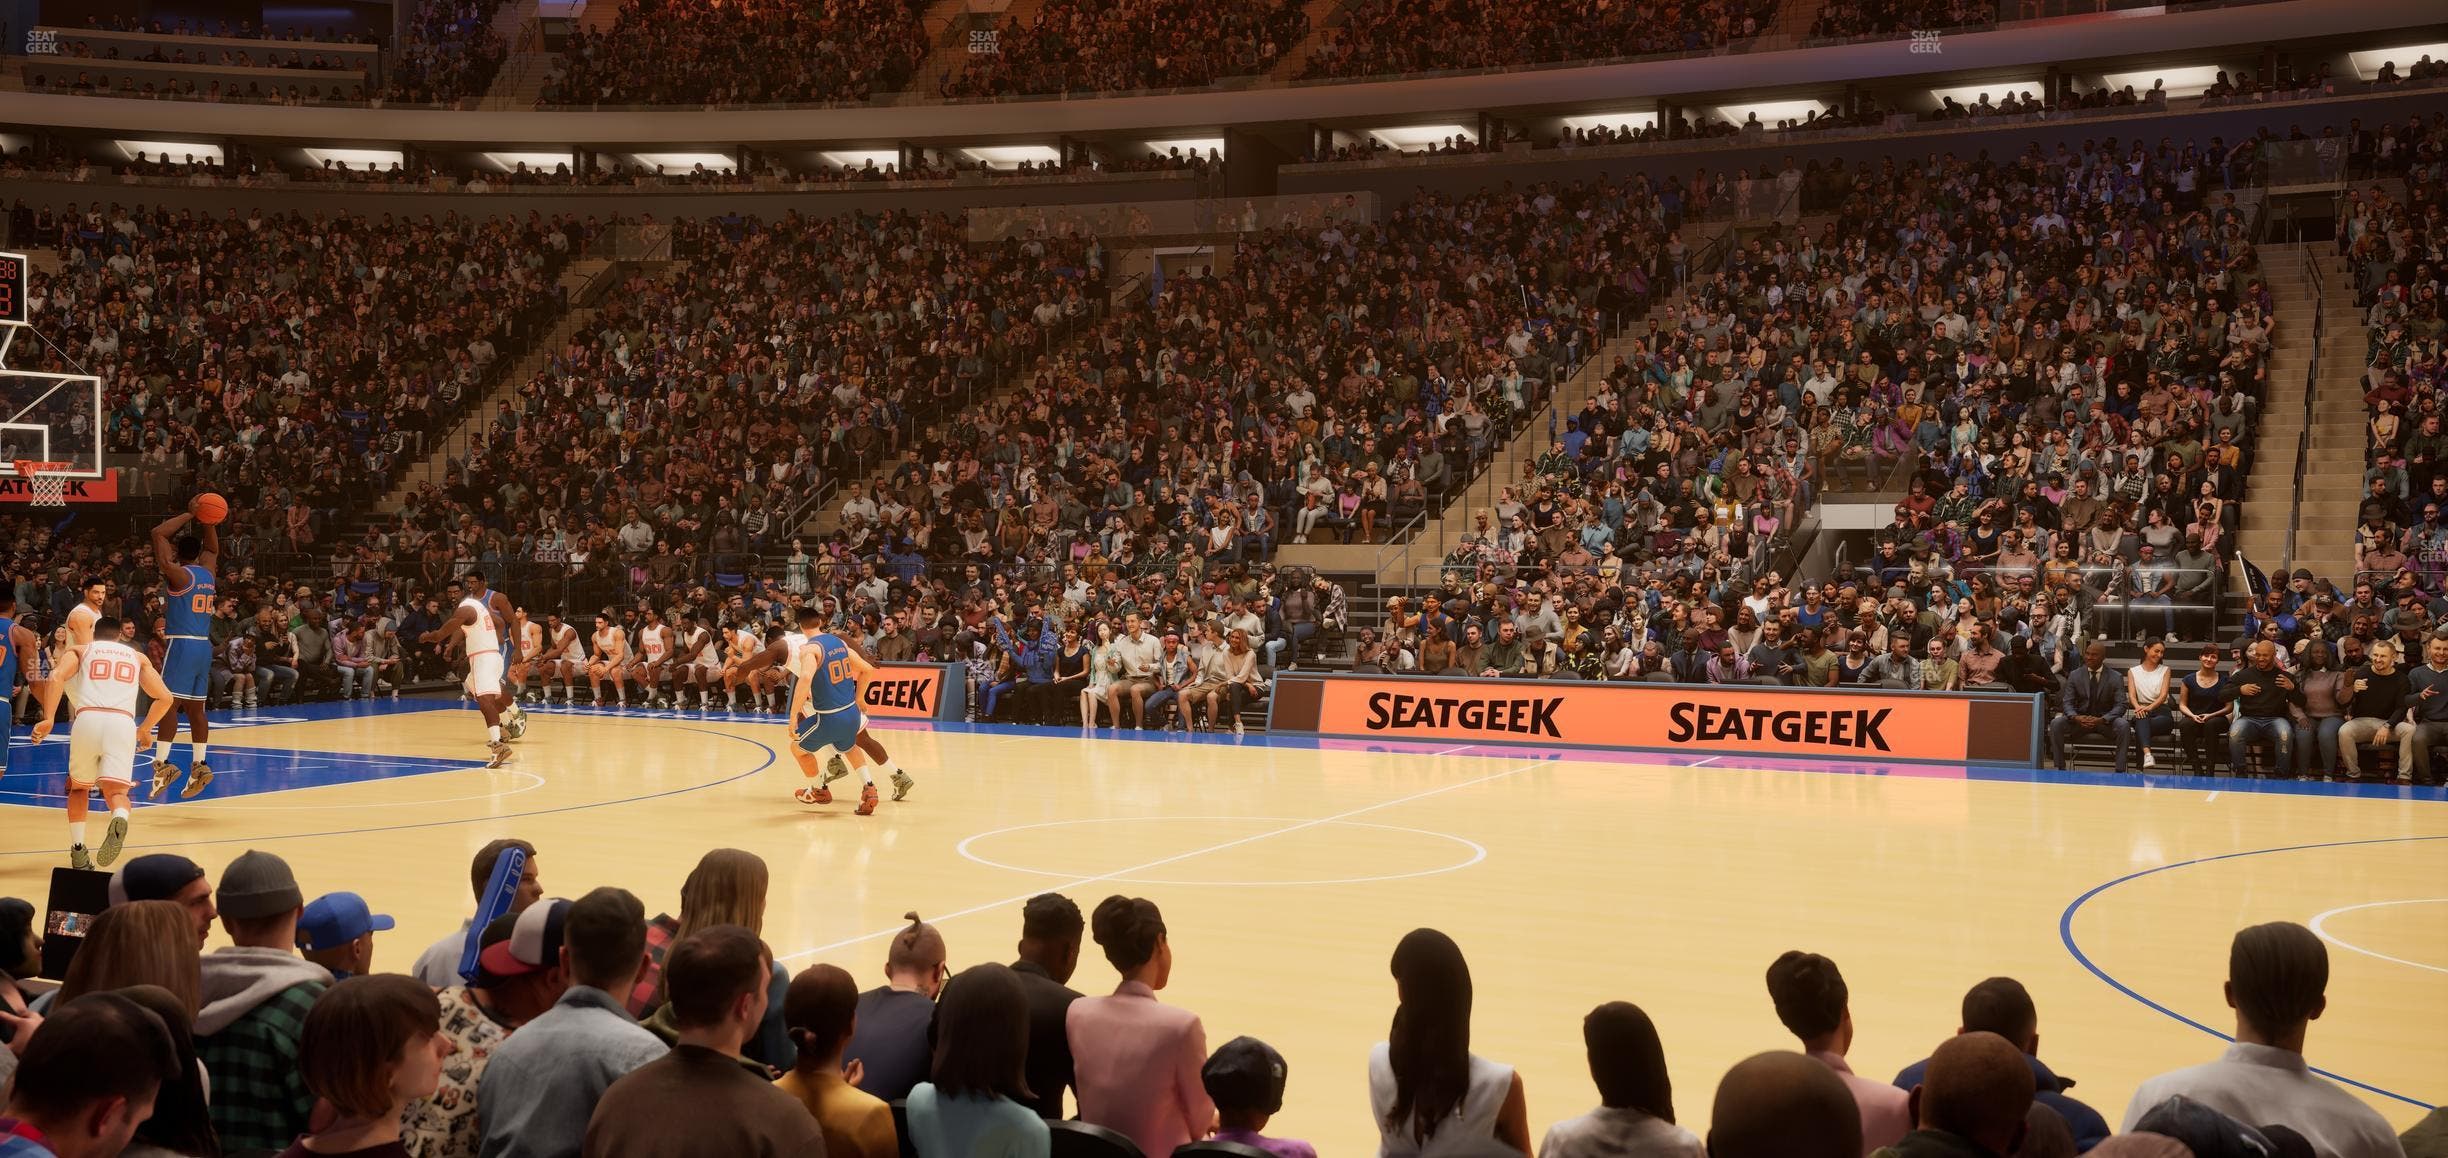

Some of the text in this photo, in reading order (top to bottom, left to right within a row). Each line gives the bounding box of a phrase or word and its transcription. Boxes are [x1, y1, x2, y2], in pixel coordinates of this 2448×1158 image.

[90, 659, 135, 684] 00
[853, 679, 932, 711] GEEK
[1366, 692, 1564, 738] SEATGEEK
[1668, 702, 1893, 751] SEATGEEK
